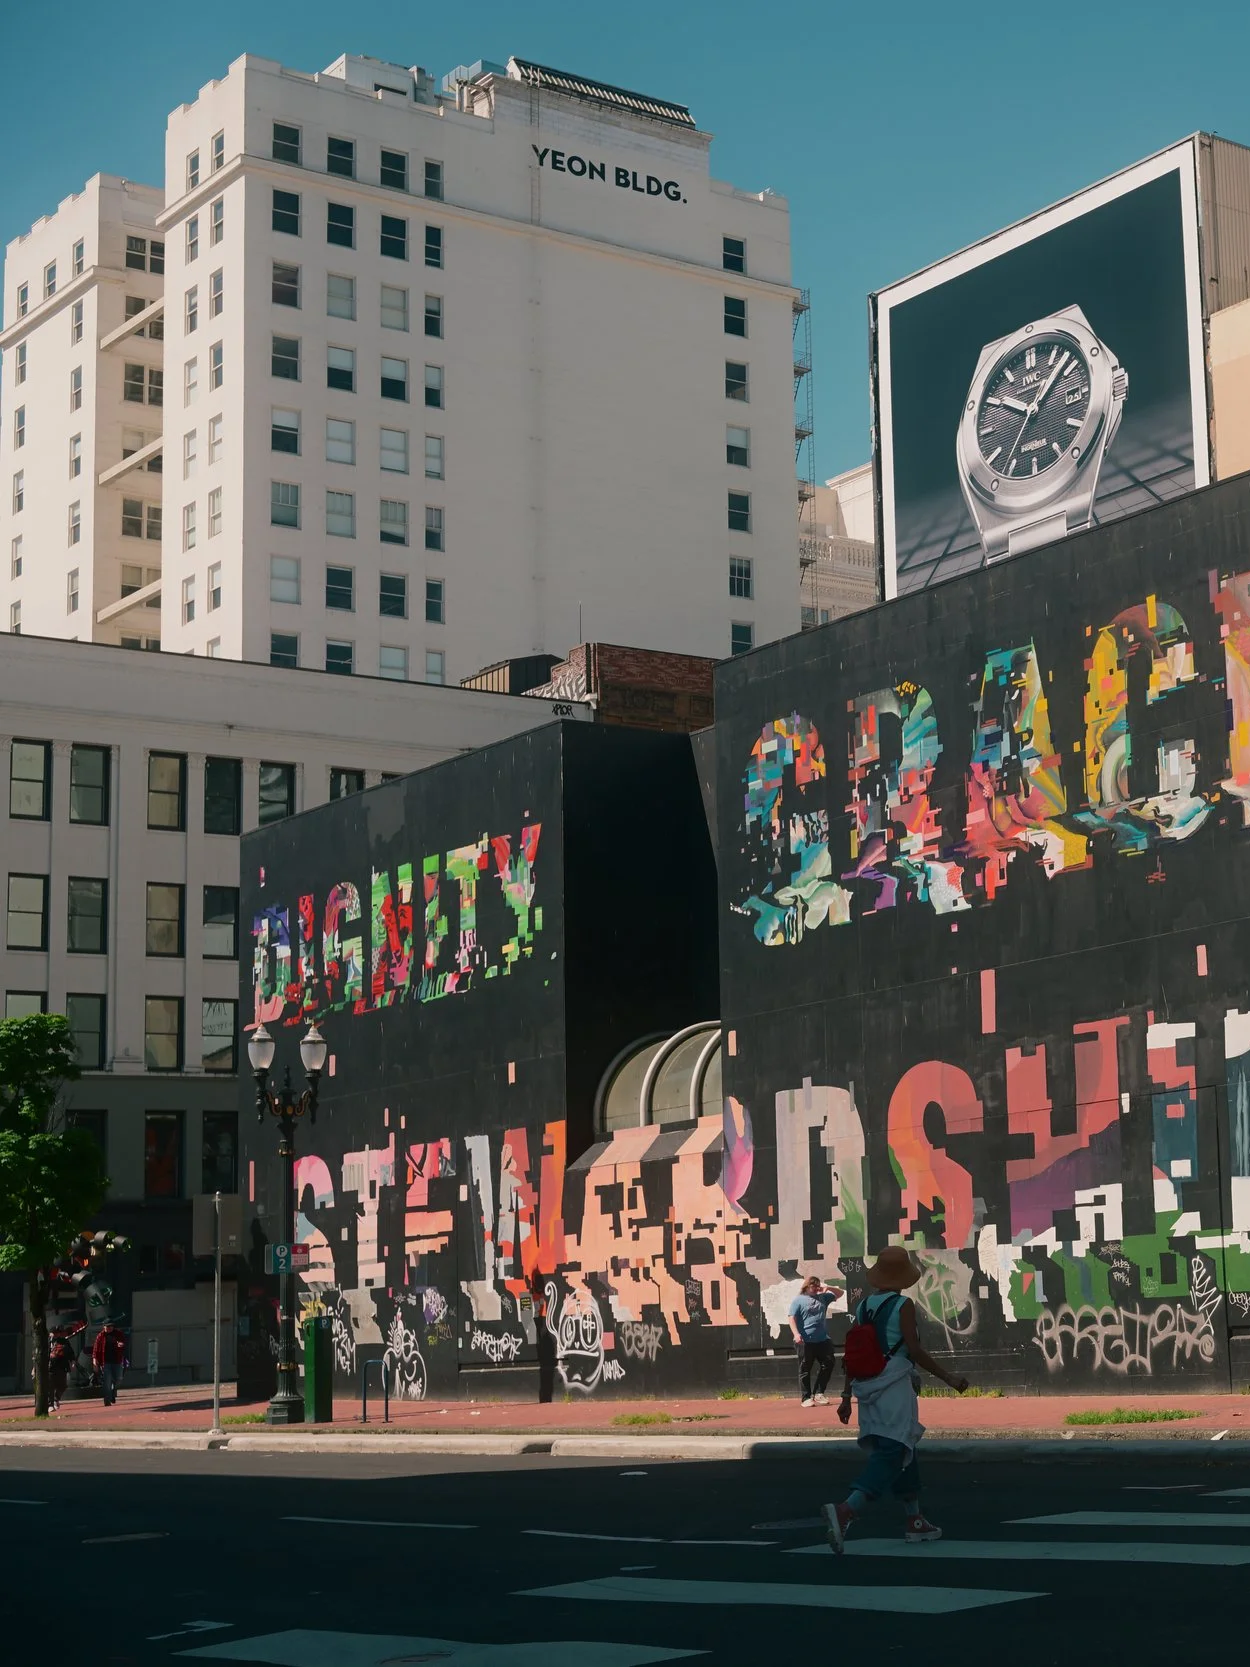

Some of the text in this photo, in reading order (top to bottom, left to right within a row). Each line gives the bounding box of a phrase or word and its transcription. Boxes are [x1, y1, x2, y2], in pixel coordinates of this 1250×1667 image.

[531, 144, 688, 204] YEON BLDG.
[1022, 371, 1041, 386] IWC
[244, 823, 543, 1031] DIGNITY
[279, 1259, 286, 1270] 2
